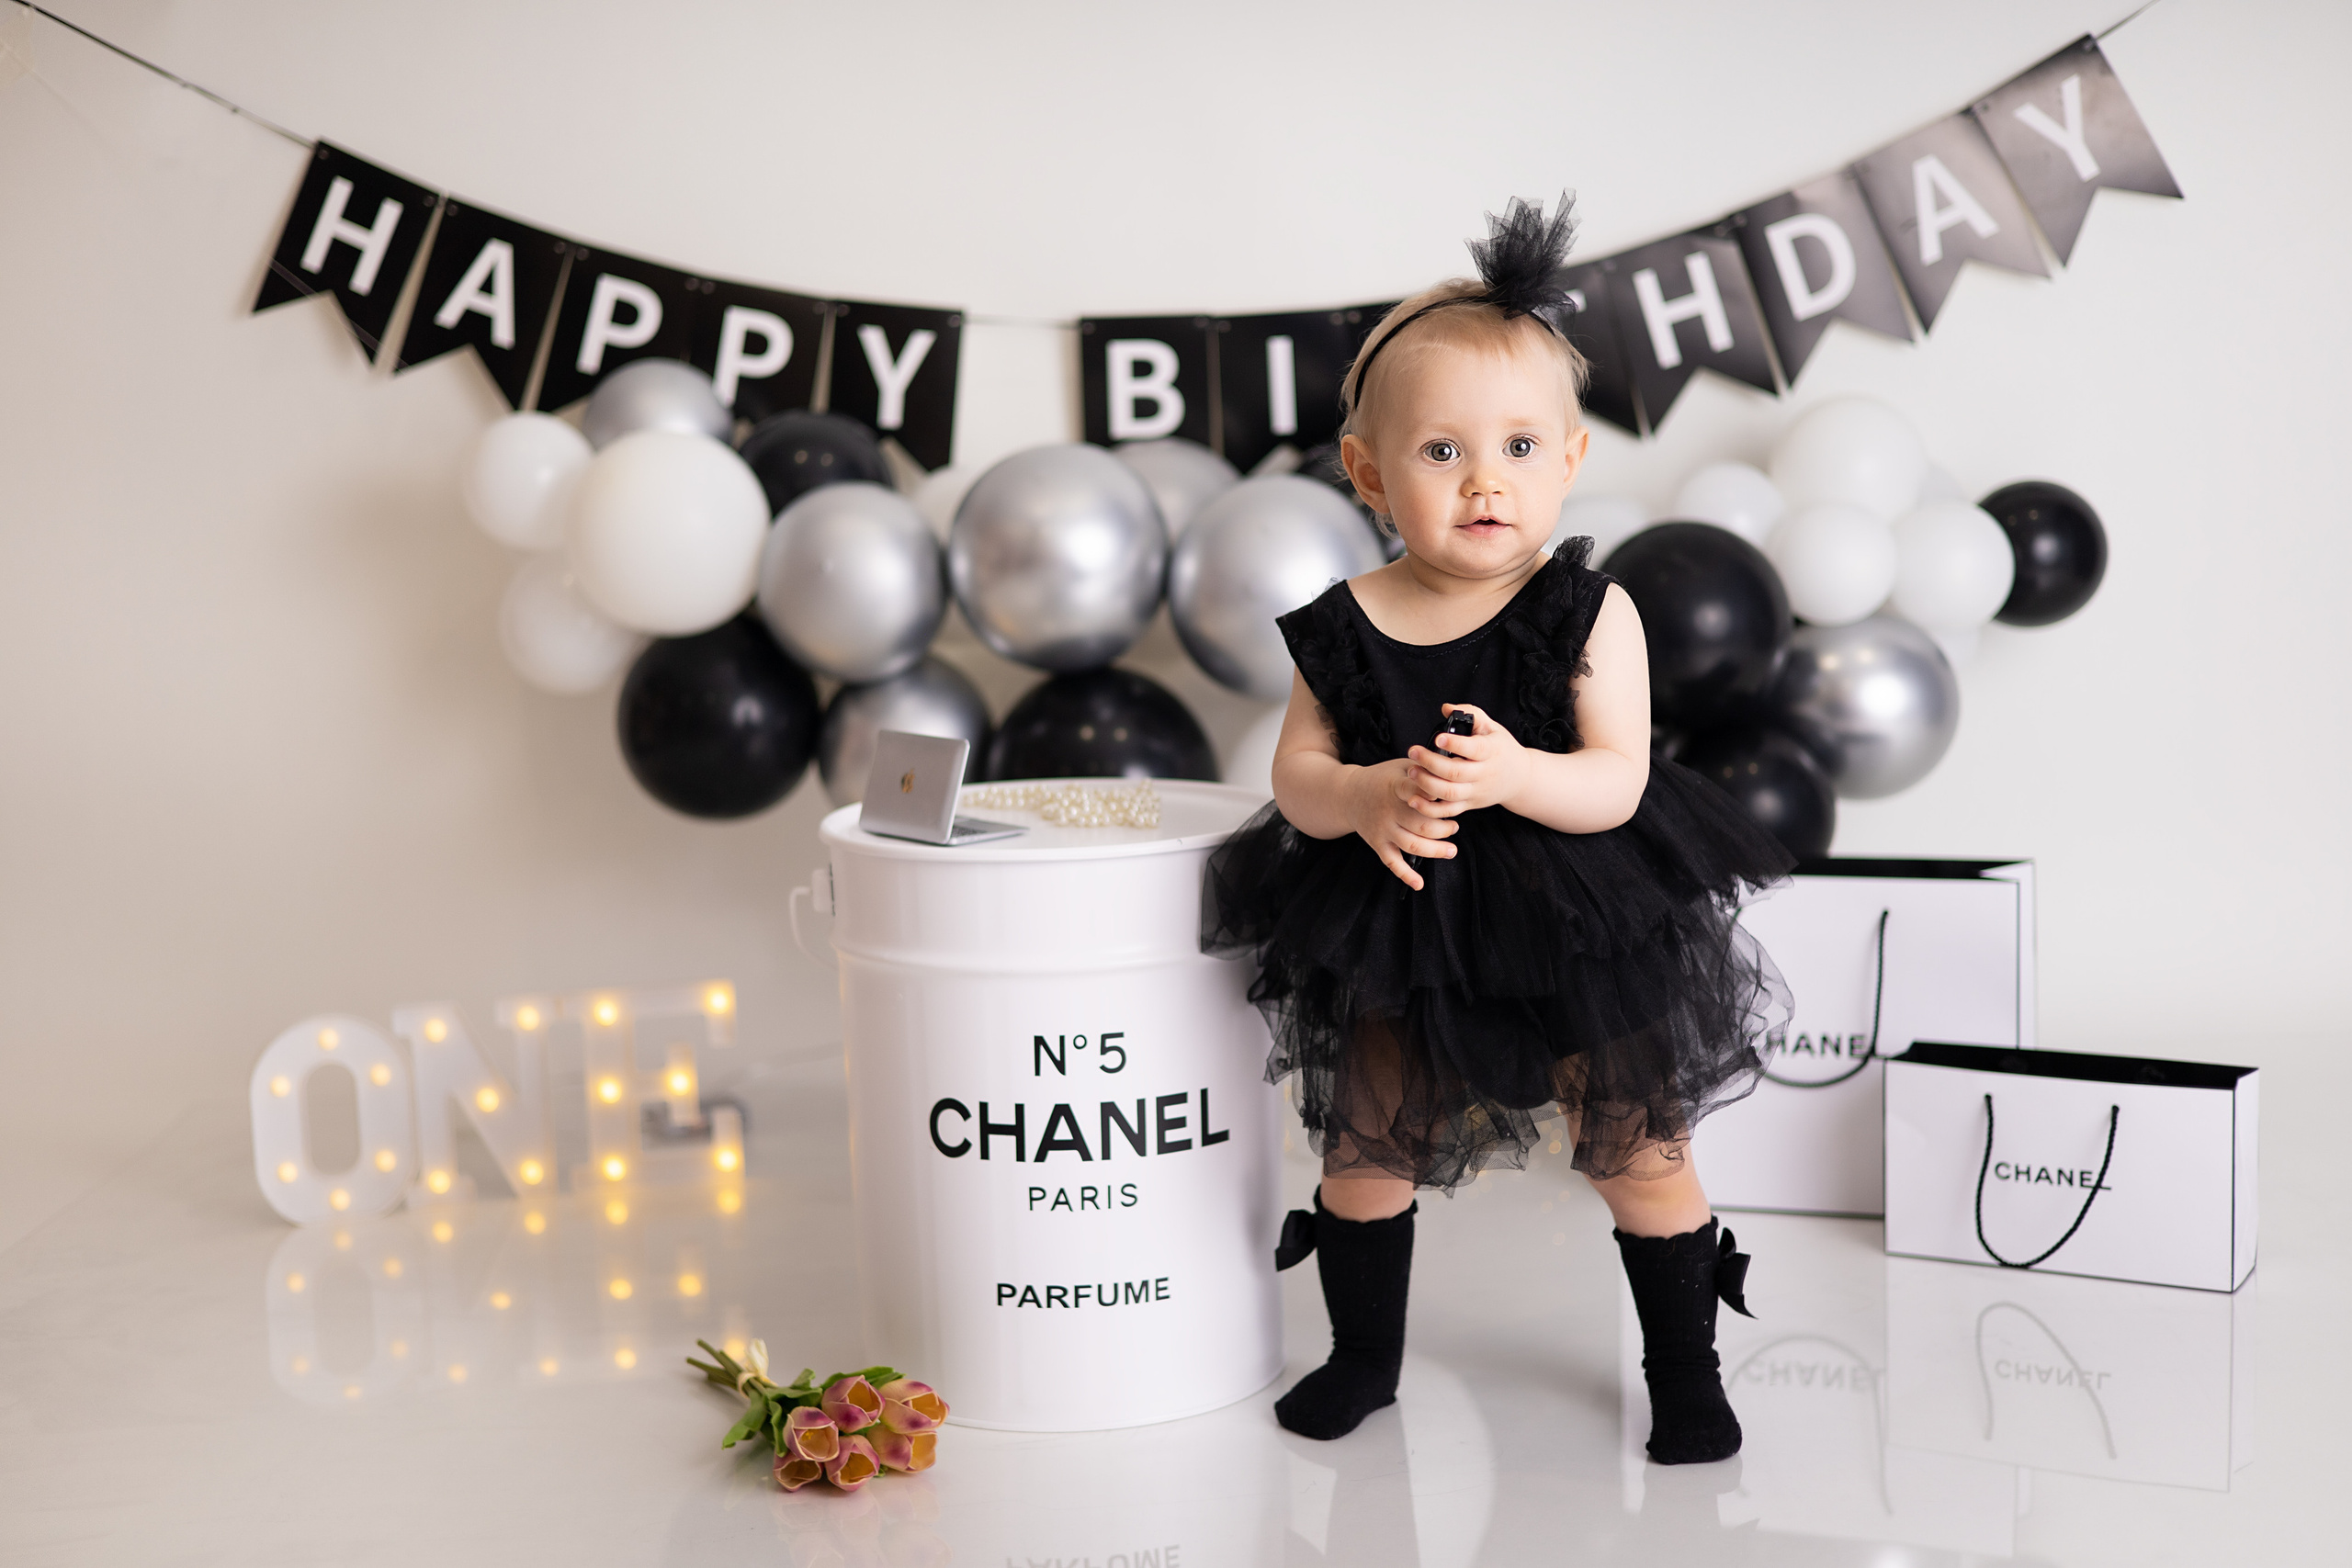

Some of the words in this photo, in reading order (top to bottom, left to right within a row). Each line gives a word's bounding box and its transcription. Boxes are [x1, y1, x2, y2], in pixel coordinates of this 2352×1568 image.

[300, 175, 937, 430] HAPPY
[1106, 74, 2105, 440] BIHDAY
[1747, 1030, 1885, 1059] HANE
[250, 977, 745, 1227] ONE
[929, 1088, 1230, 1163] CHANEL
[1029, 1183, 1138, 1212] PARIS
[996, 1277, 1171, 1309] PARFUME
